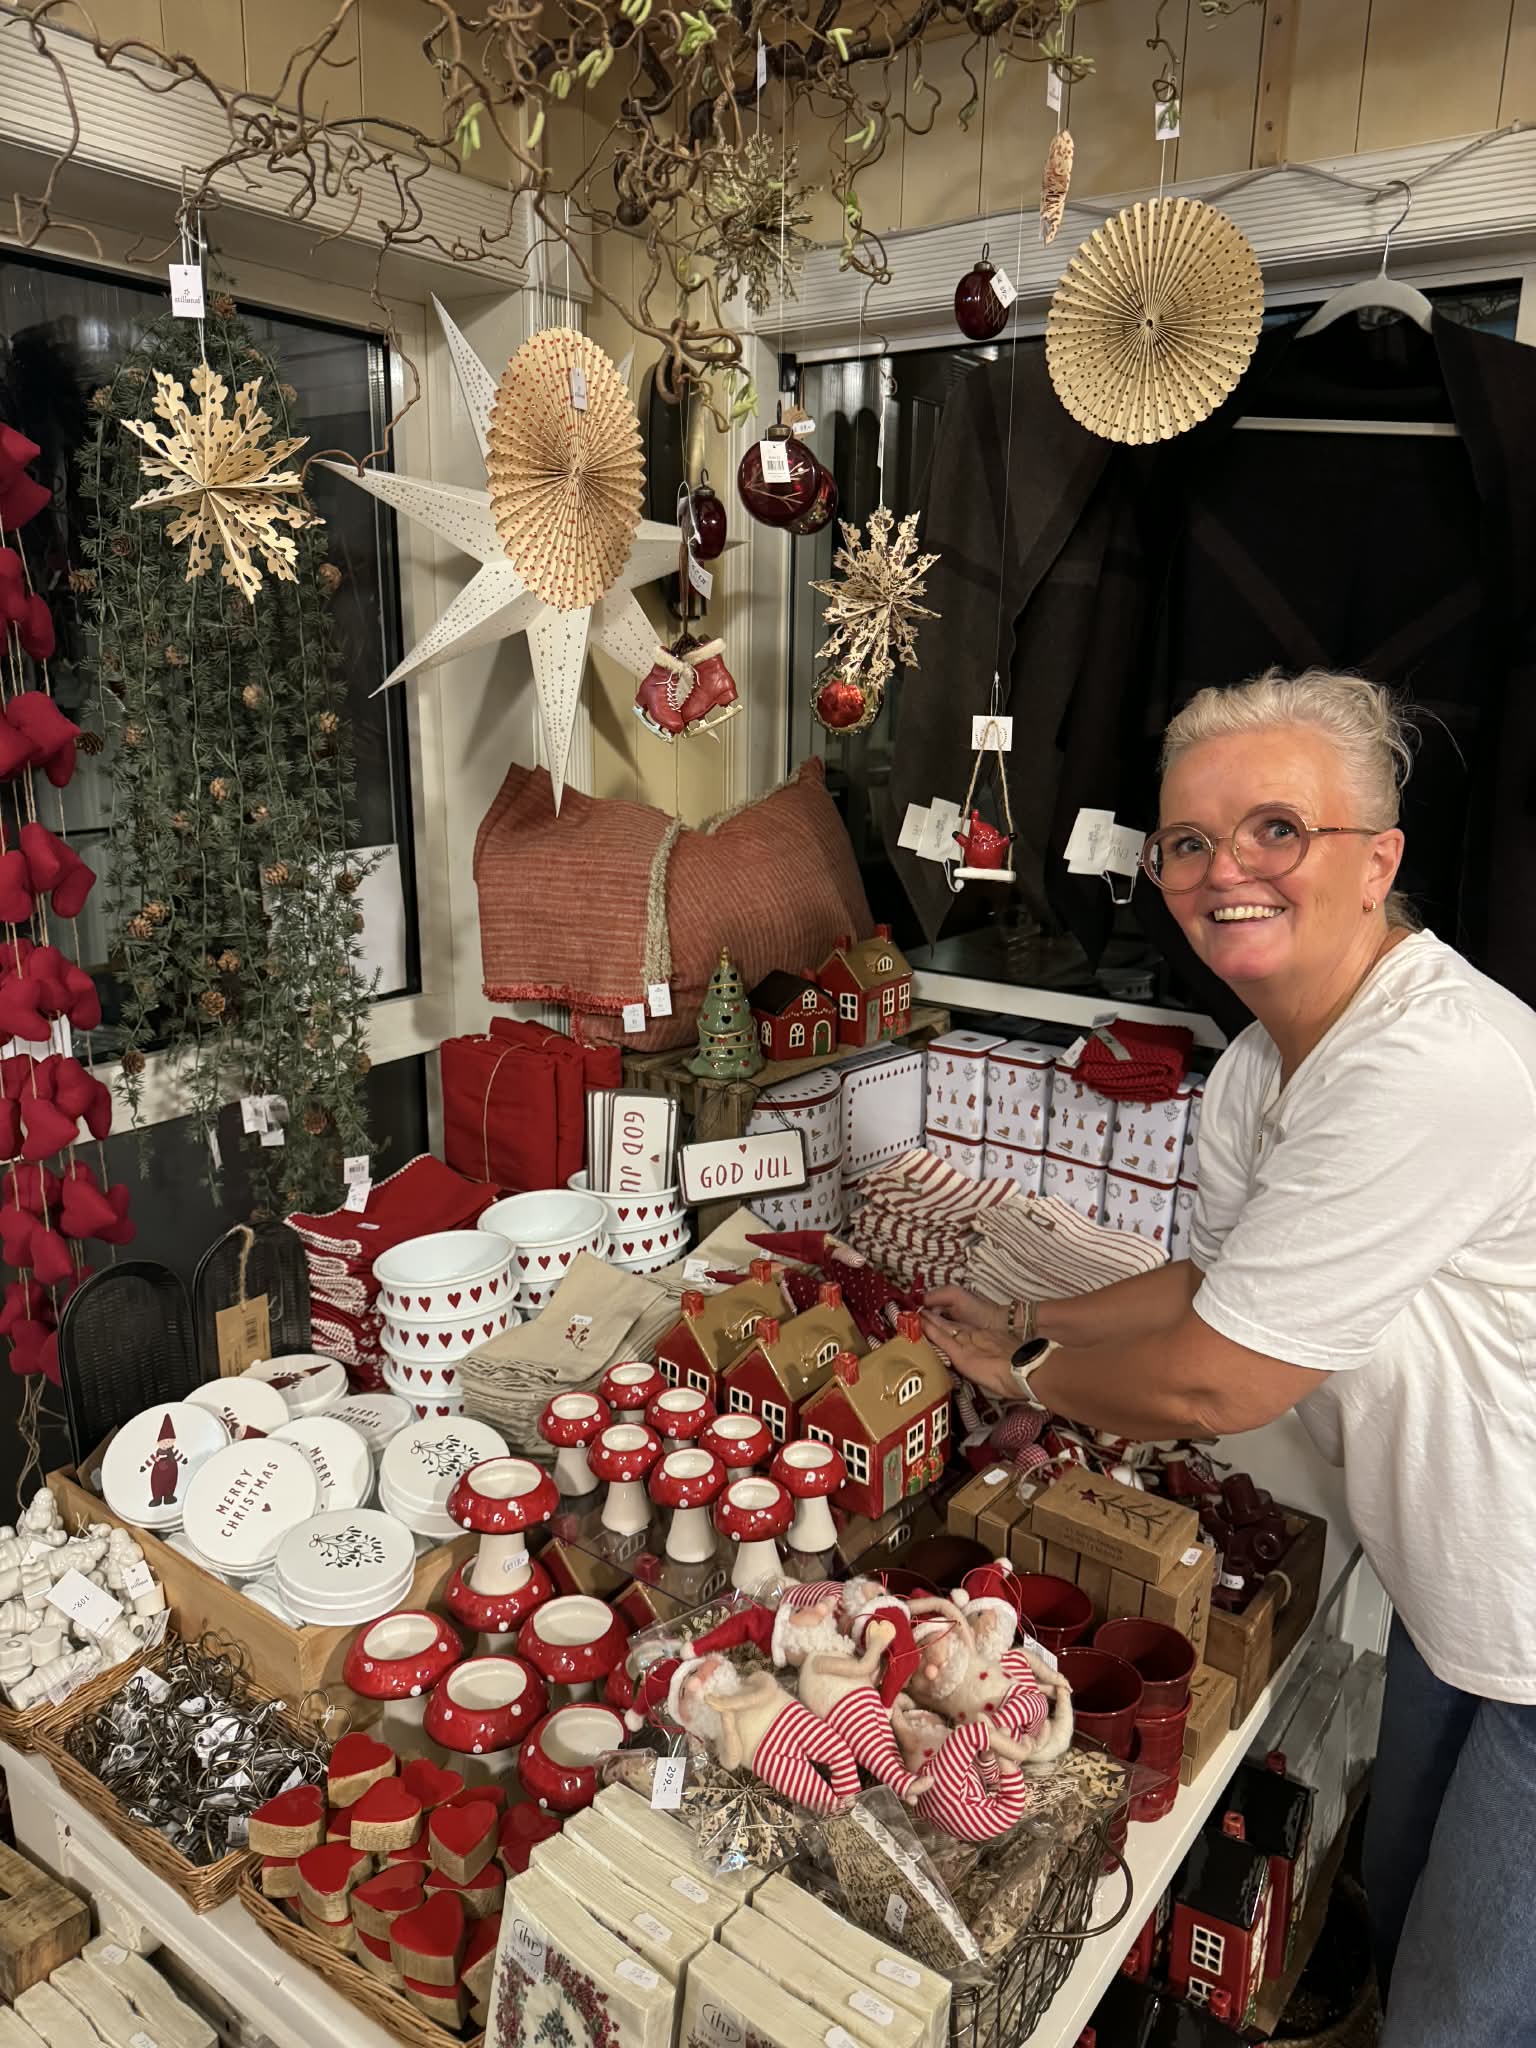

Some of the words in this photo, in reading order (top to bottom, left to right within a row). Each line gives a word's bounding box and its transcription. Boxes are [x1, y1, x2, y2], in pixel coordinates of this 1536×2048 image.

[622, 1111, 645, 1155] GOD
[619, 1165, 643, 1192] JU
[700, 1162, 743, 1188] GOD
[754, 1156, 792, 1181] JUL
[343, 1406, 381, 1419] MERRY
[309, 1446, 336, 1489] MERRY
[216, 1468, 253, 1515] MERRY
[221, 1461, 279, 1537] CHRISTMAS
[518, 1925, 539, 1953] ihr
[711, 2010, 731, 2037] ihr
